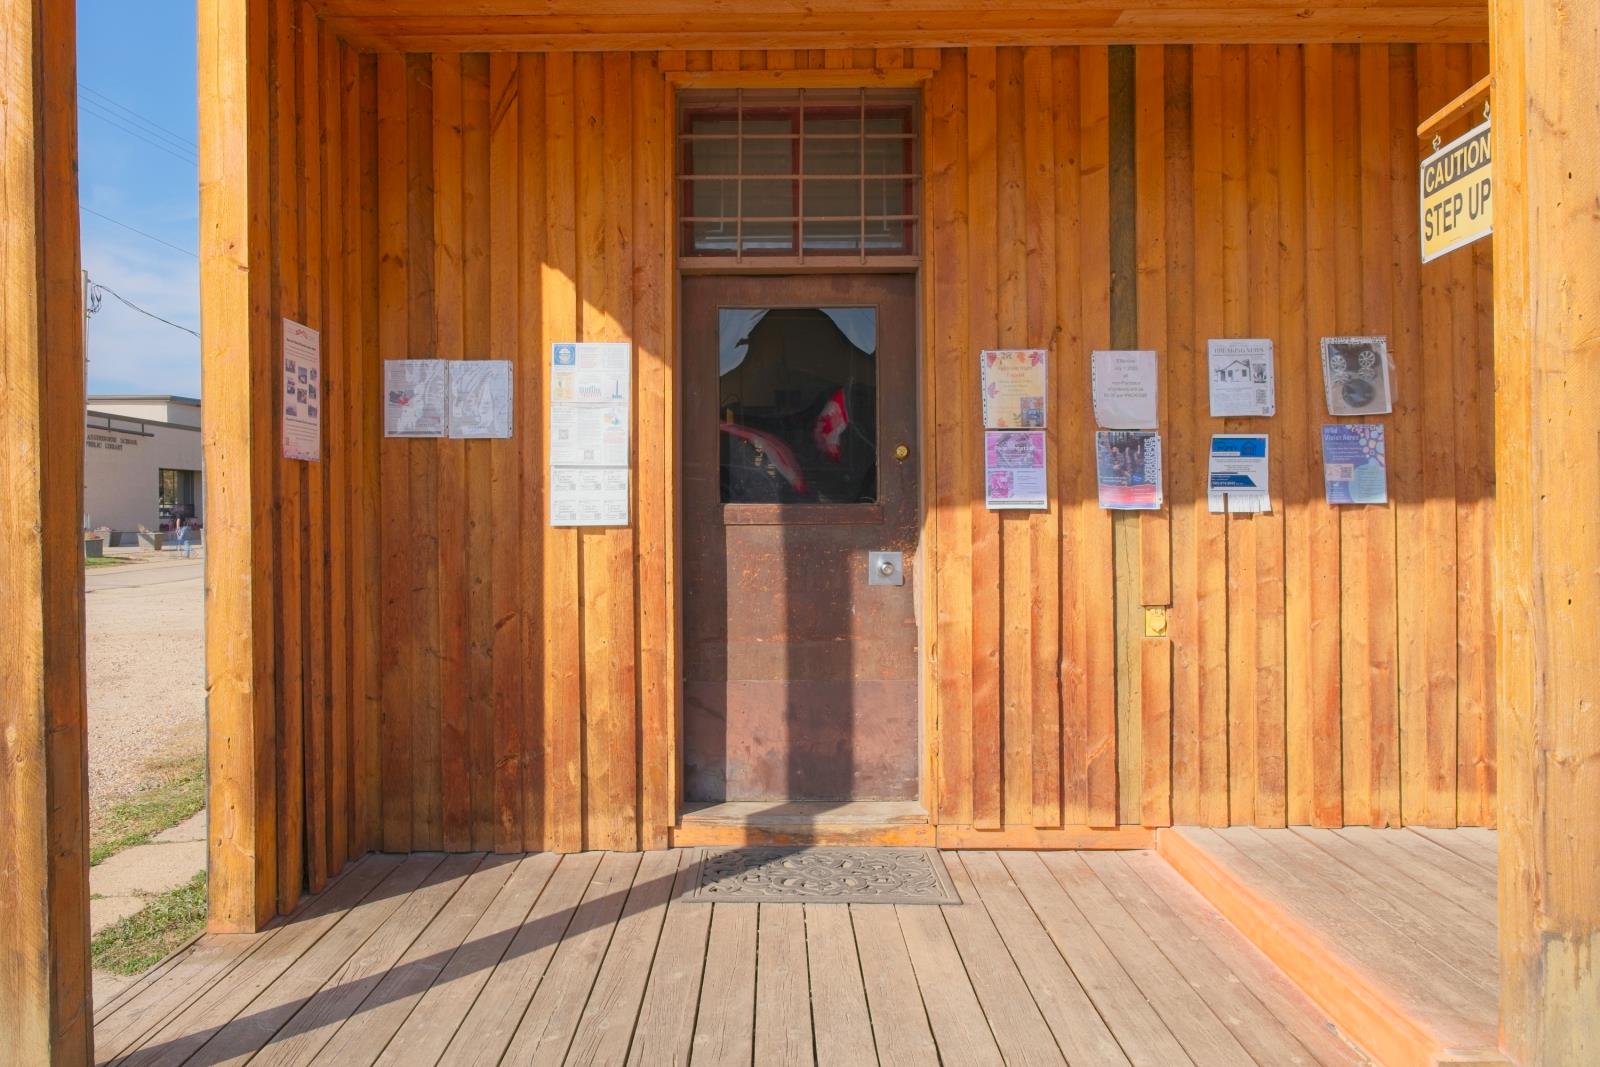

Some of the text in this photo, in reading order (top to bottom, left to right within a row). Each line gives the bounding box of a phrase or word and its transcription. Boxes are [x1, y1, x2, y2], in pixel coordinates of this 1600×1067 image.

[1425, 133, 1491, 193] CAUTION
[1425, 177, 1491, 242] STEP UP
